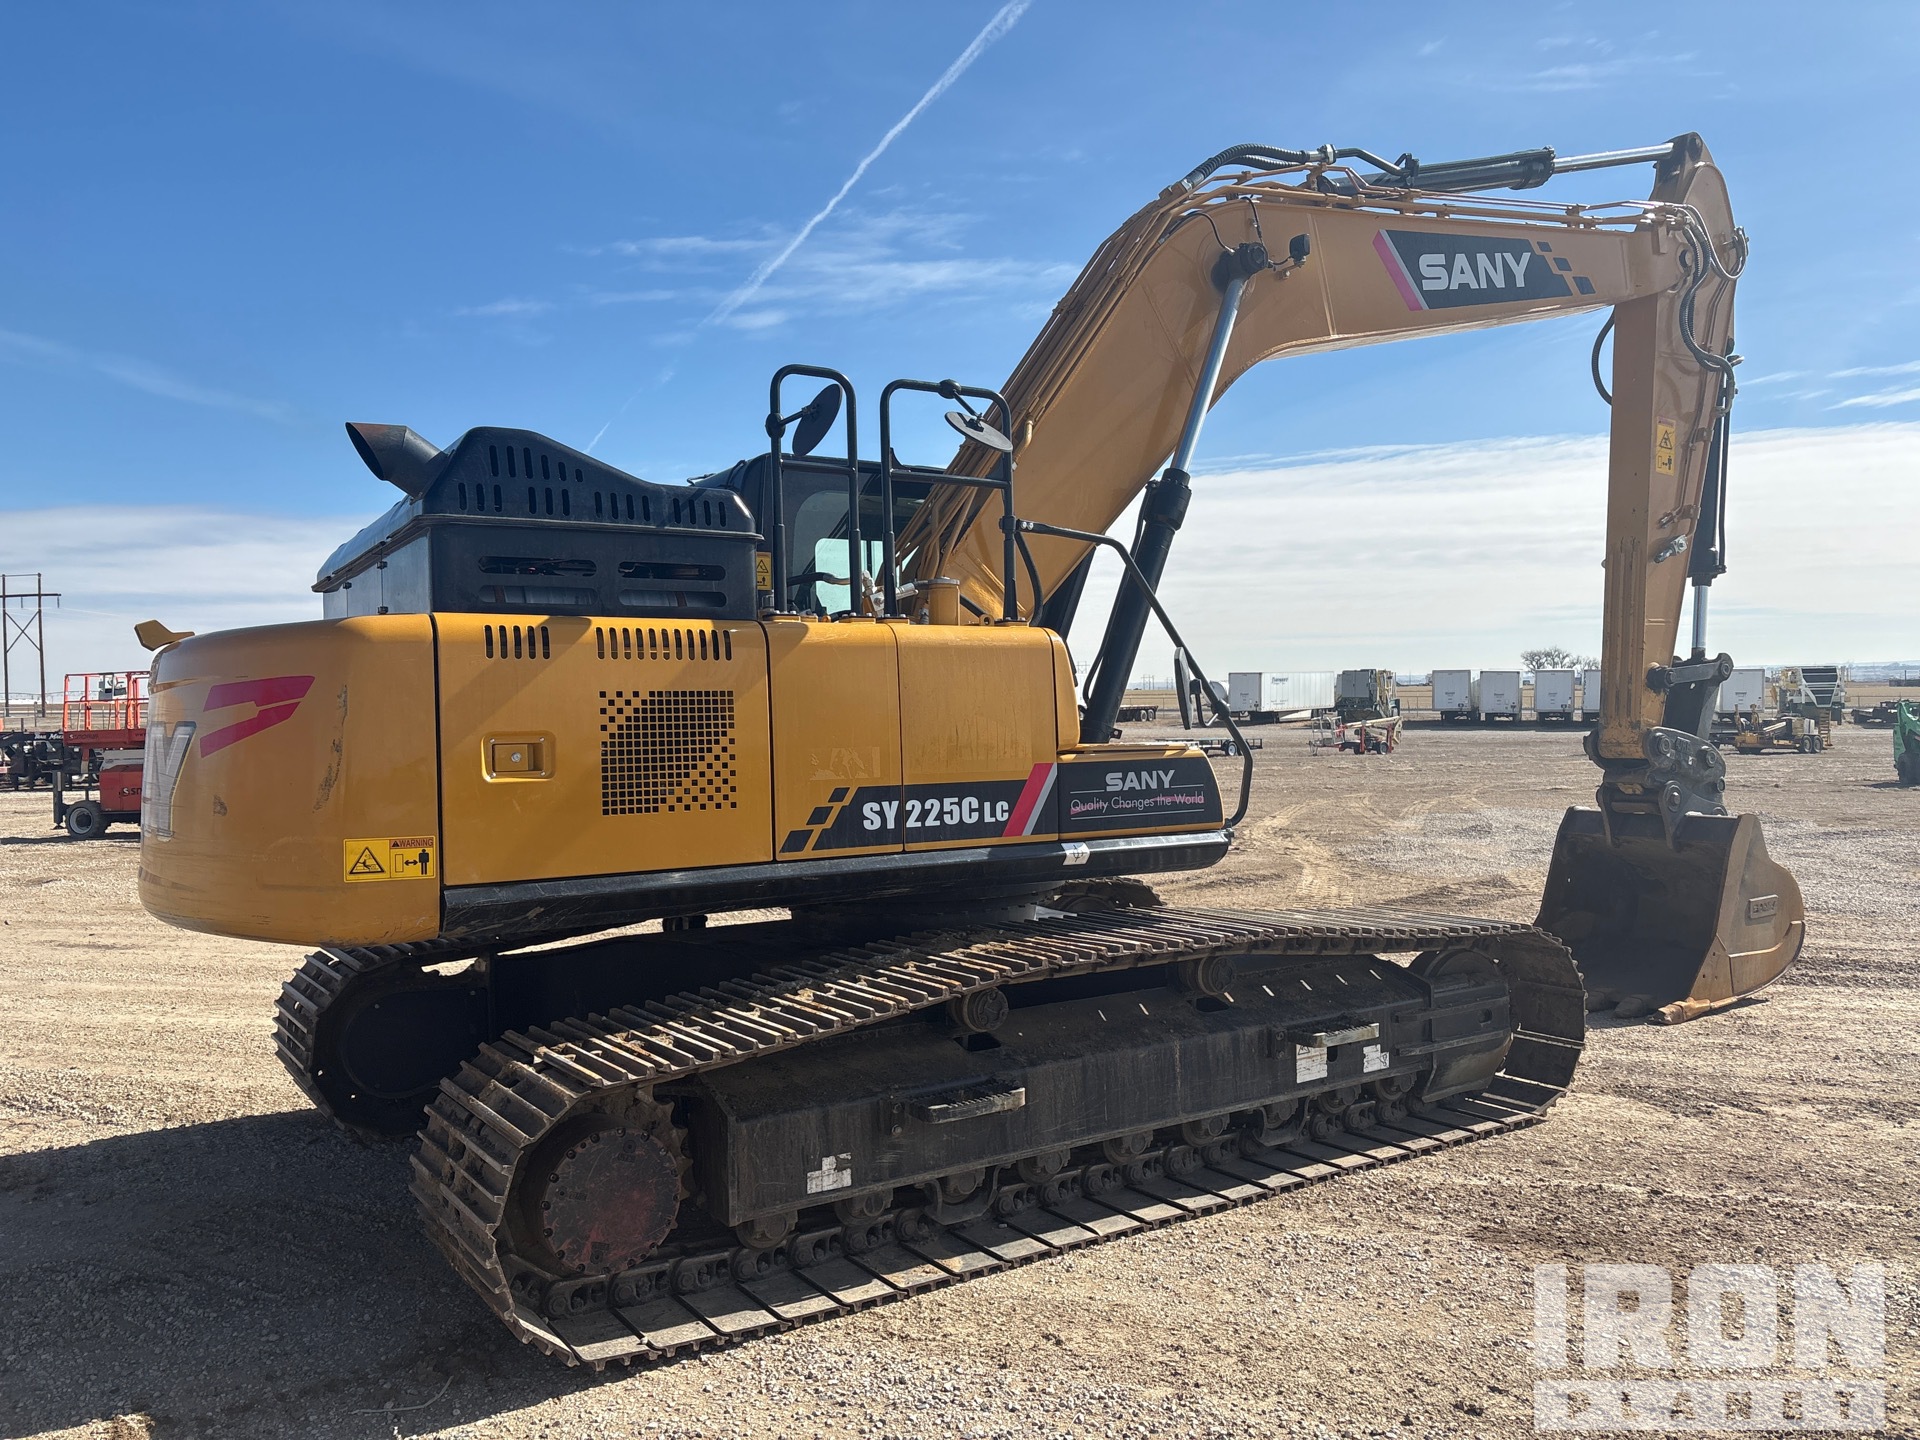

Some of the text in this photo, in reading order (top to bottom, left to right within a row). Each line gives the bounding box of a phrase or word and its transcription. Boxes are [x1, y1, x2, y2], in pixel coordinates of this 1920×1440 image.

[1418, 252, 1531, 291] SANY
[1105, 769, 1176, 792] SANY
[1070, 791, 1204, 813] Quality Changes the World
[399, 838, 434, 848] WARNING
